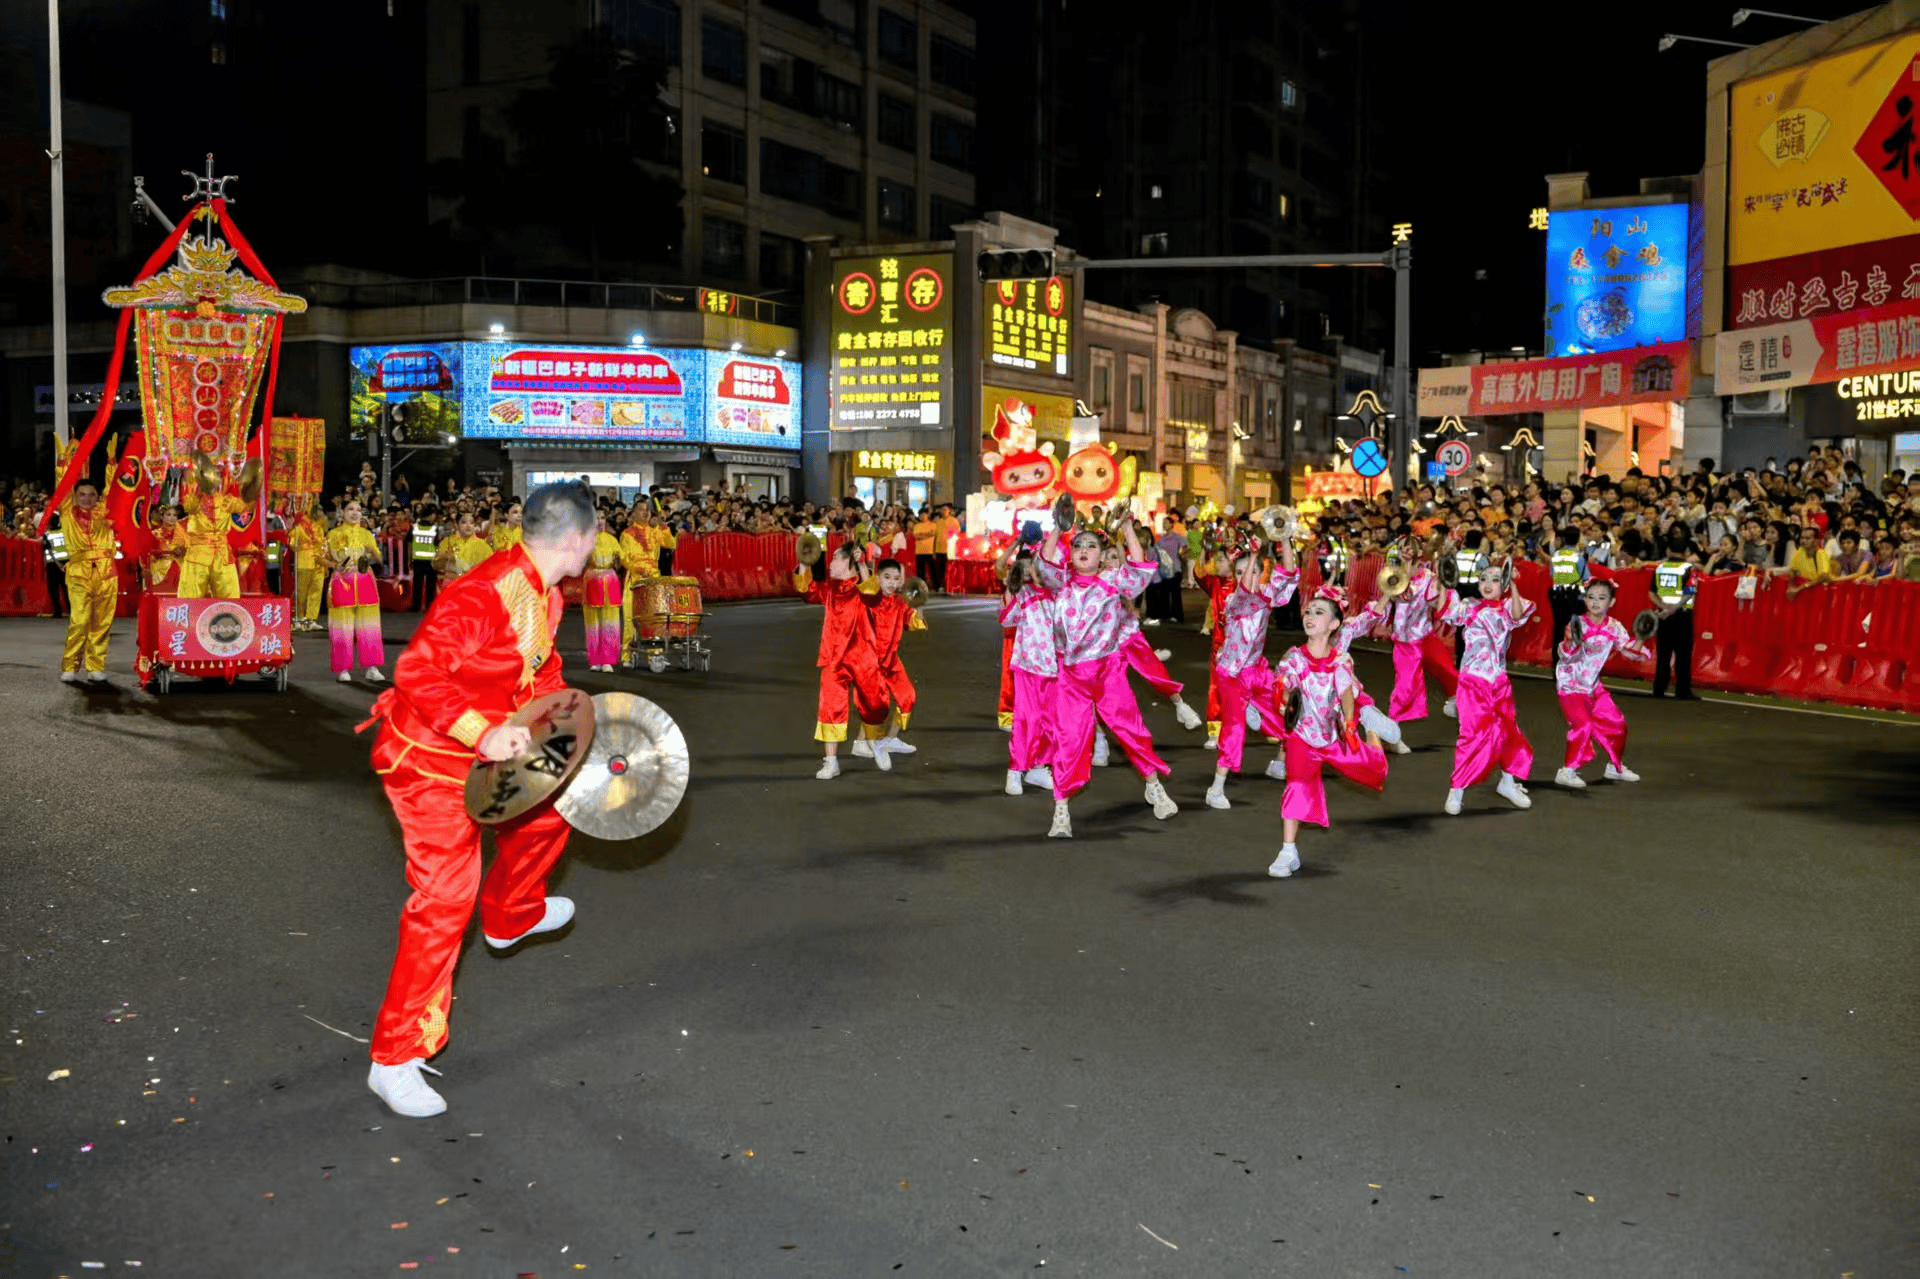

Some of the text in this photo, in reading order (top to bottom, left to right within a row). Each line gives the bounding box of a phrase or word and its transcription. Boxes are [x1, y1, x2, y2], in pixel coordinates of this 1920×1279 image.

[1529, 207, 1549, 230] 地
[1591, 216, 1647, 238] 阳山
[846, 278, 936, 307] 寄 存
[838, 328, 943, 350] 黄金寄存回收行
[1446, 450, 1463, 466] 30
[166, 603, 190, 657] 明星
